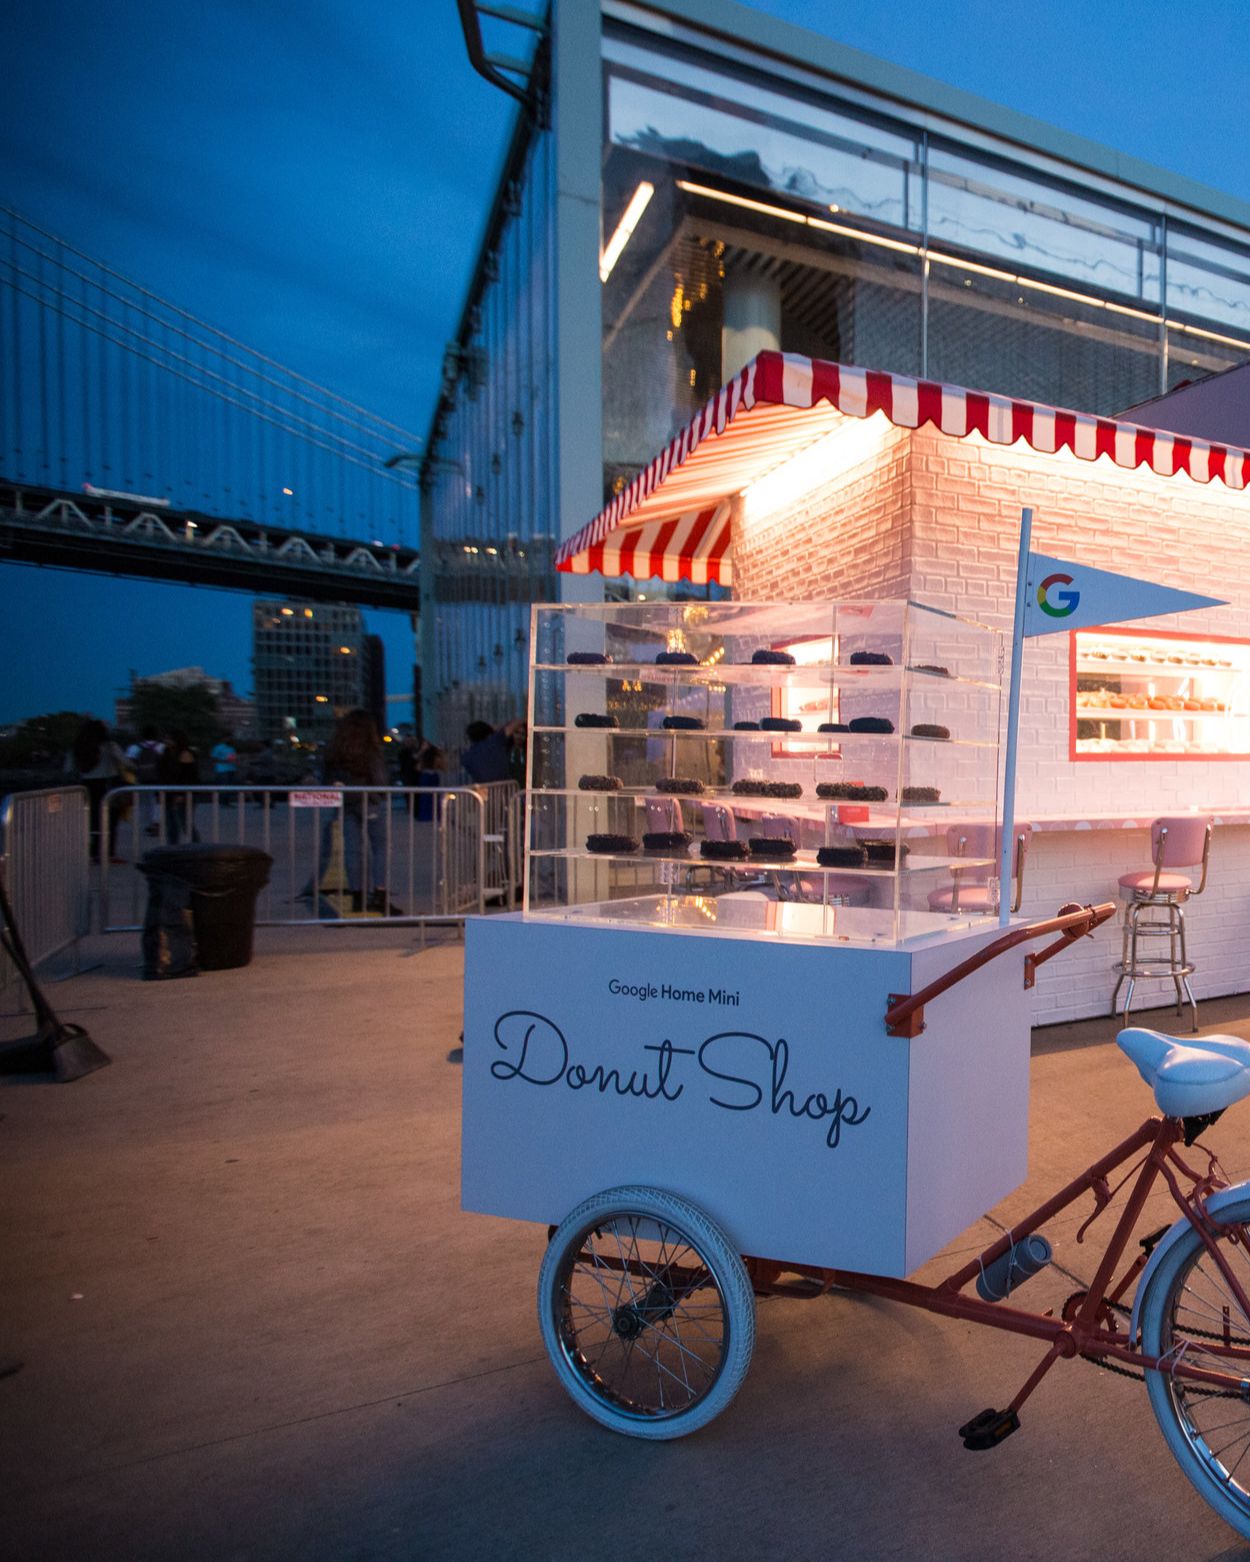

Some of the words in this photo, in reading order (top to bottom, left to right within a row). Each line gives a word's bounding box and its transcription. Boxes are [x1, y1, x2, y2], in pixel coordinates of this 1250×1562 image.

[1037, 573, 1080, 618] G
[608, 978, 658, 1001] Google
[661, 983, 705, 1003] Home
[708, 988, 740, 1007] Mini
[490, 1010, 696, 1102] Donut
[698, 1031, 872, 1149] Shop
